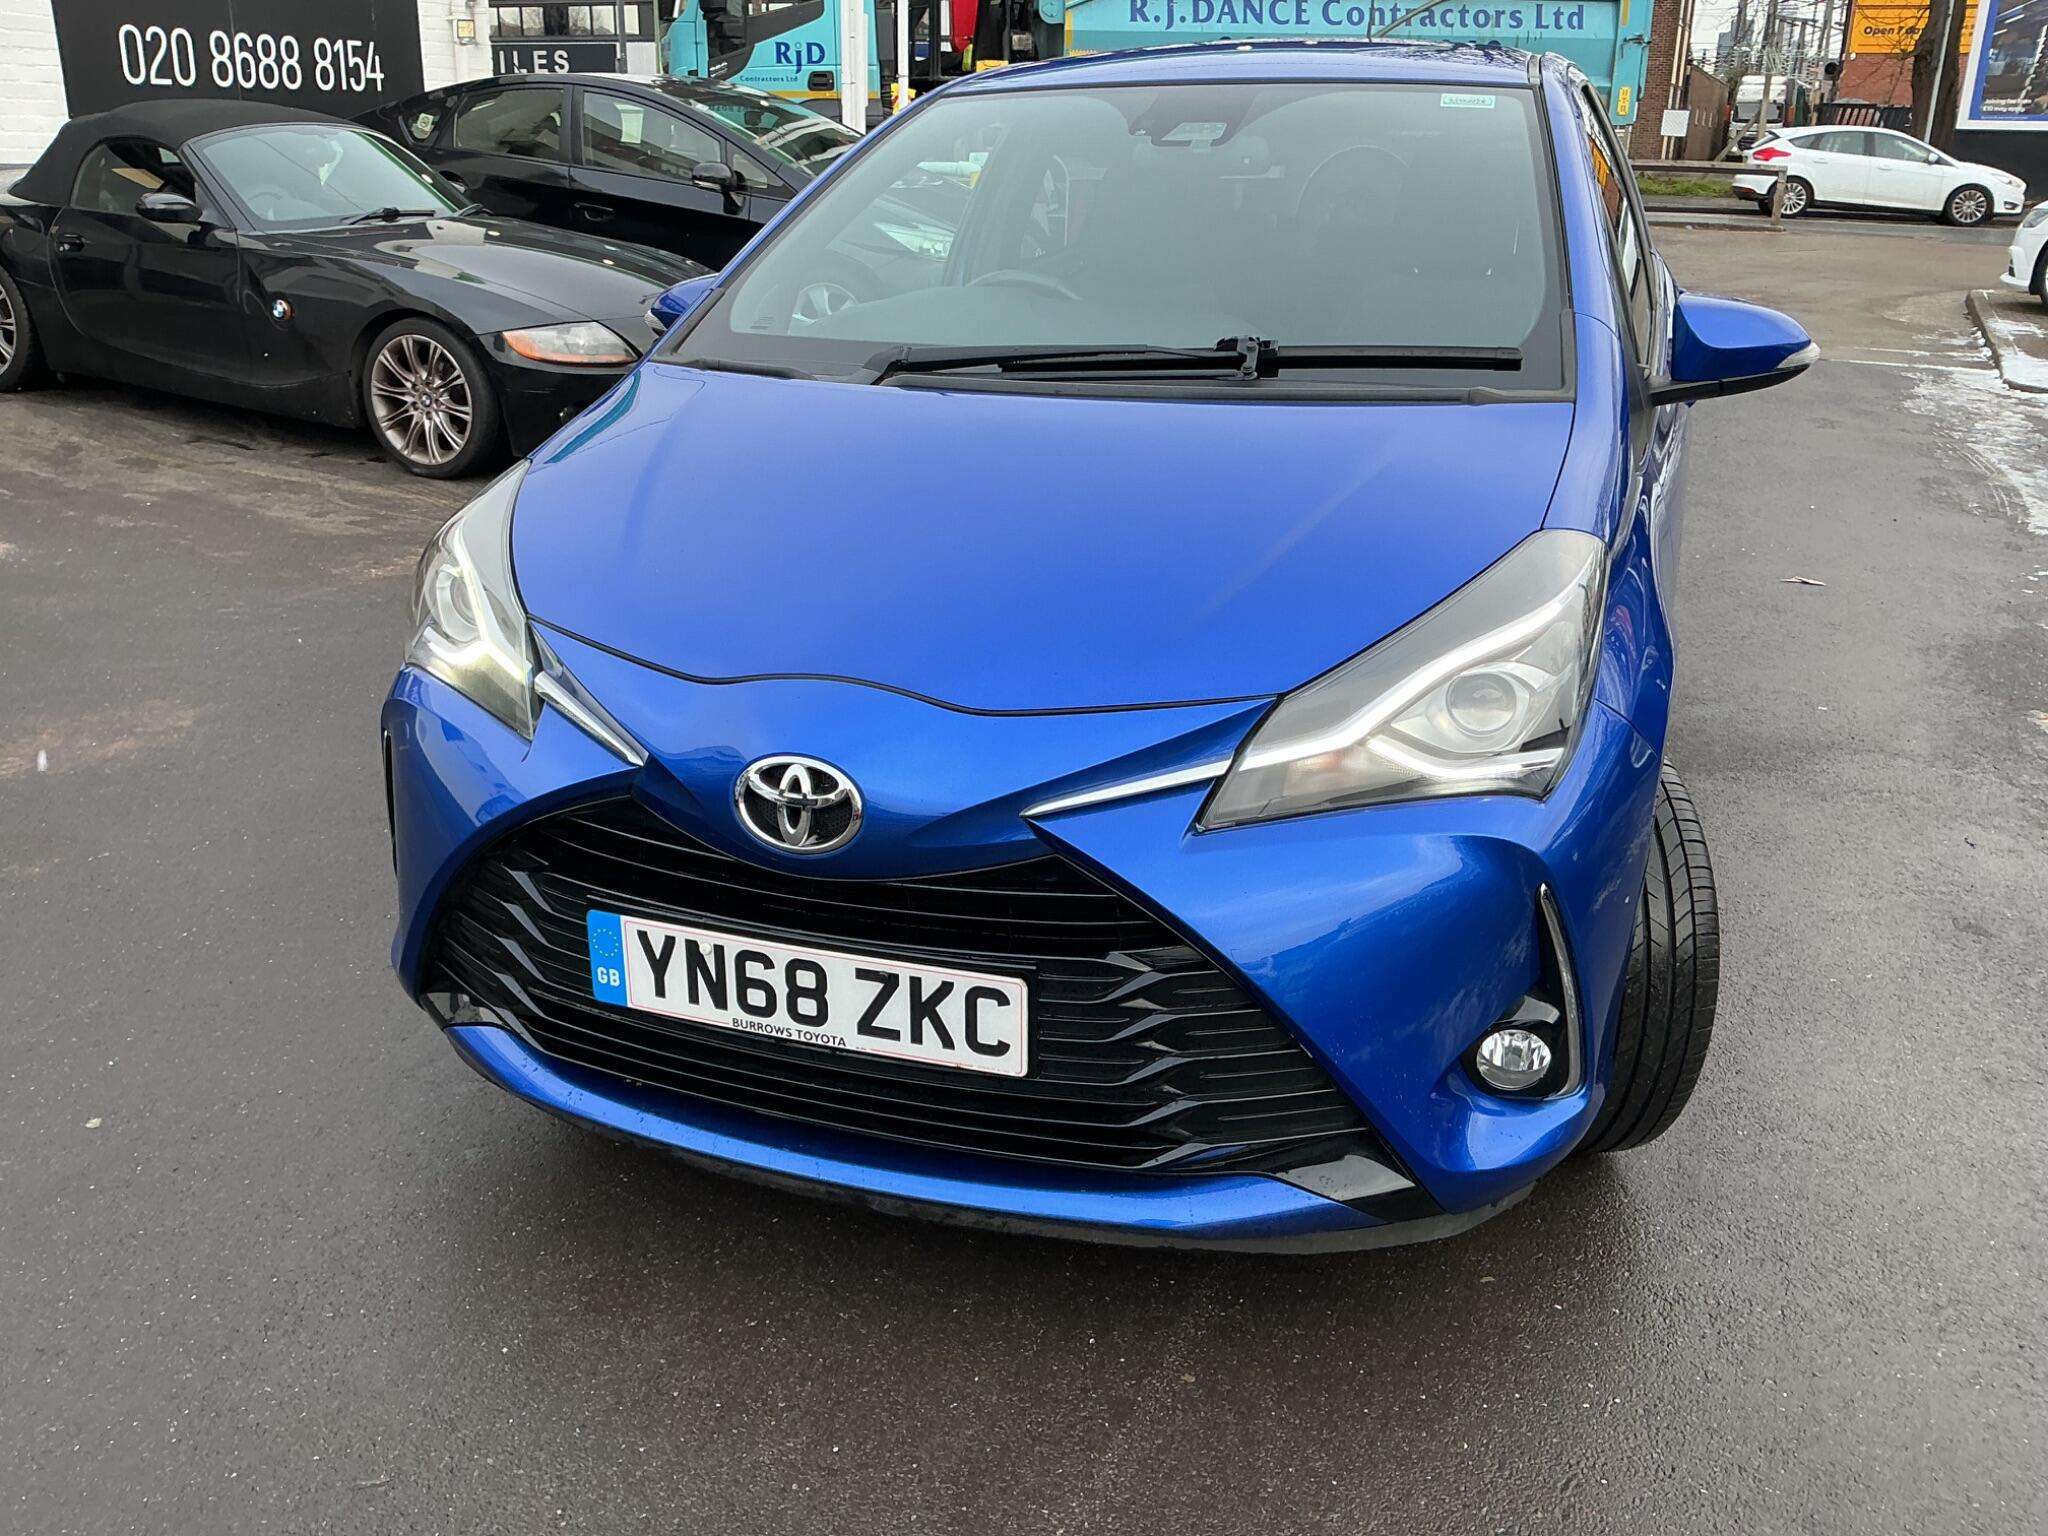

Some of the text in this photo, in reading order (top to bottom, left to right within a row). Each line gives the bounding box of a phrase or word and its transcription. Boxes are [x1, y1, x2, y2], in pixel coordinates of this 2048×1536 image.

[1321, 0, 1523, 29] Contractors
[1535, 3, 1584, 30] Ltd
[1864, 26, 1895, 37] Open
[118, 23, 385, 92] 020 8688 8154
[740, 75, 784, 83] Contractors
[597, 966, 620, 988] GB
[636, 929, 1011, 1057] YN68 ZKC
[732, 1017, 847, 1047] BURROWS TOYOTA
